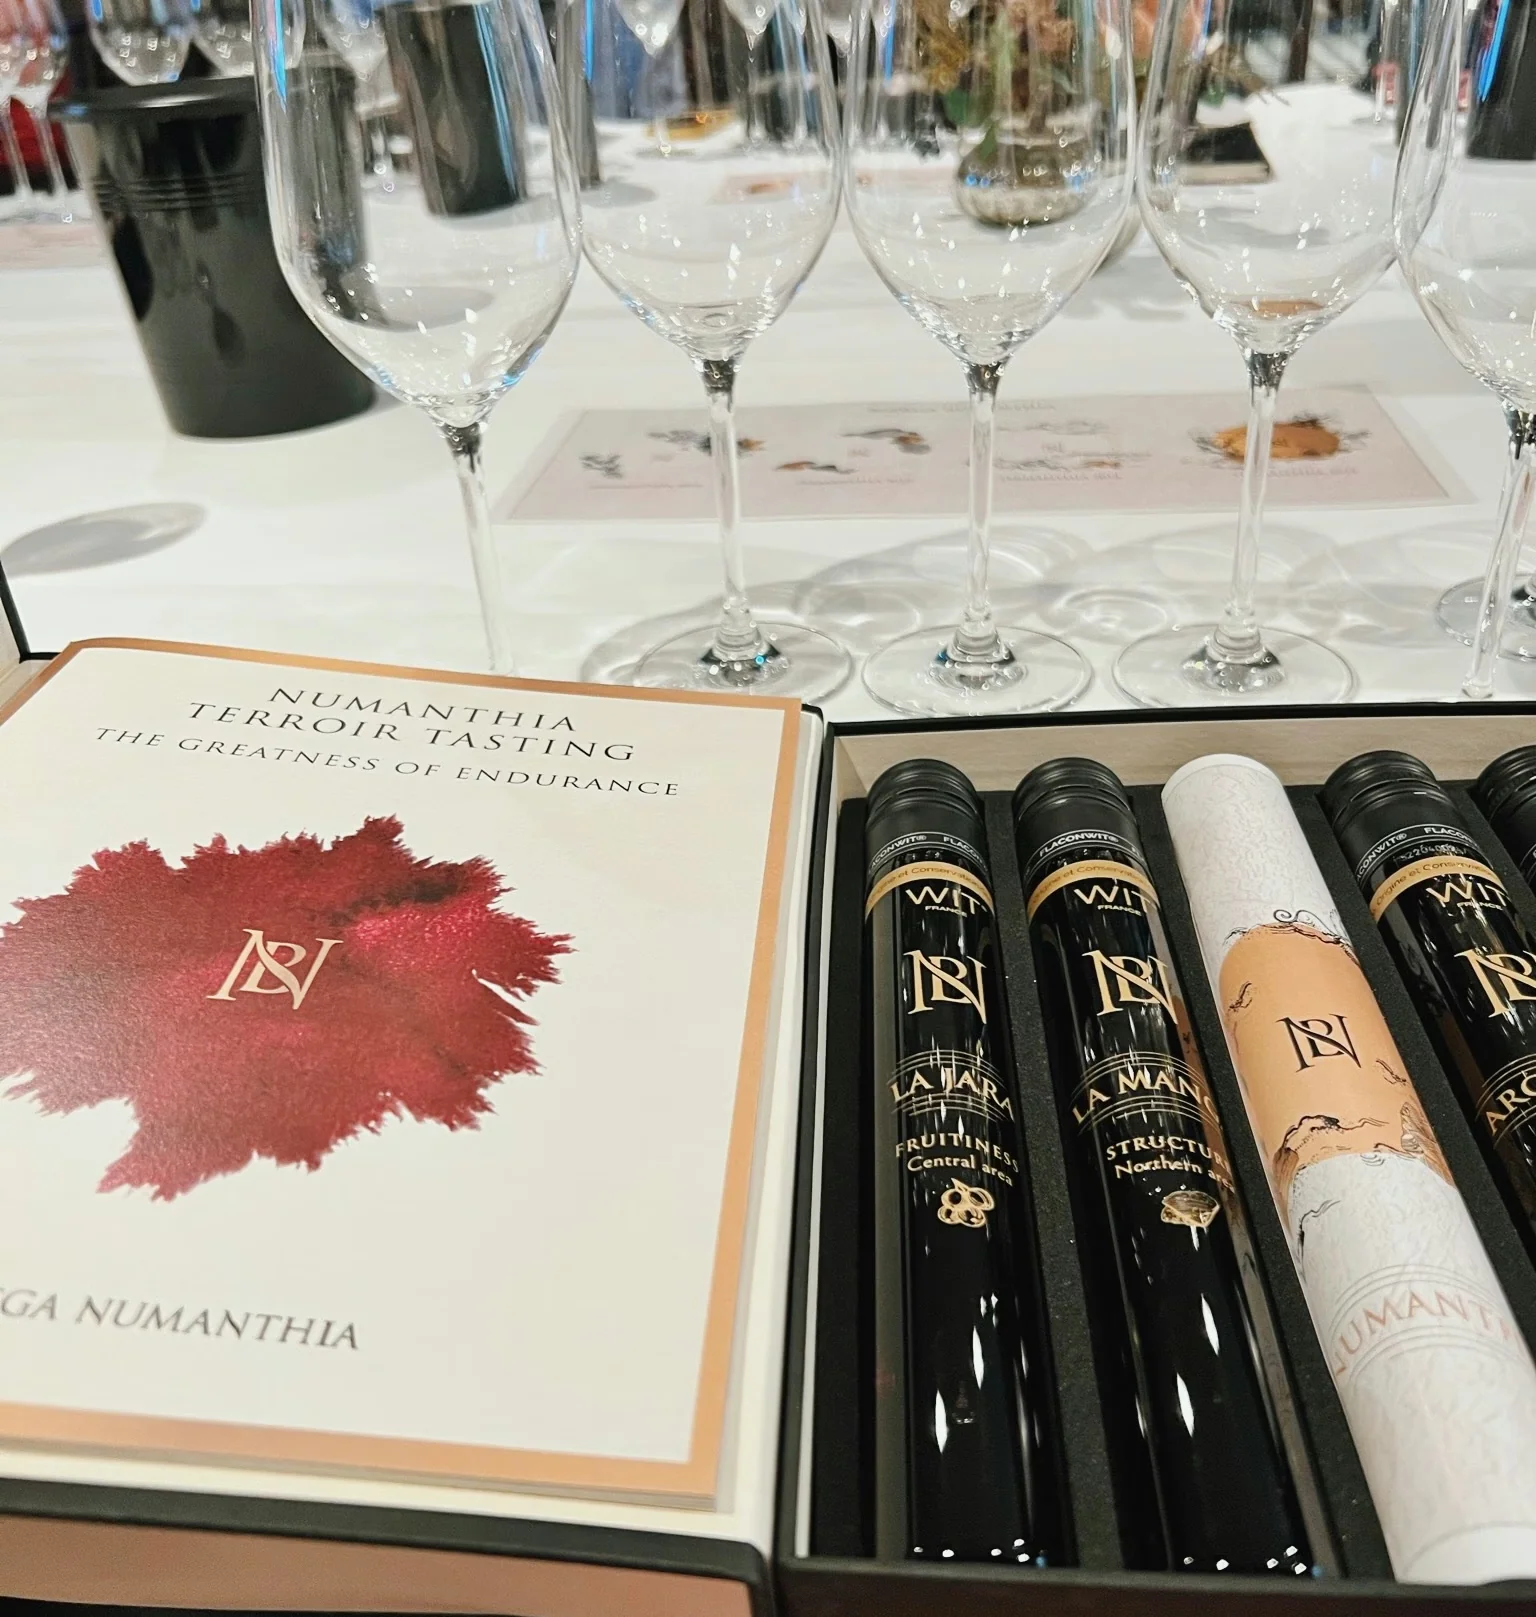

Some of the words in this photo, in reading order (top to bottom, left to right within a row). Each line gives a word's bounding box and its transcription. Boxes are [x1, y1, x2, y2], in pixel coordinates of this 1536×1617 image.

[267, 687, 577, 732] NUMANTHIA
[188, 702, 401, 742] TERROIR
[425, 727, 635, 761] TASTING
[96, 727, 165, 747] THE
[177, 738, 380, 771] GREATNESS
[394, 761, 441, 777] OF
[455, 766, 679, 796] ENDURANCE
[905, 885, 988, 915] WIT
[1073, 885, 1158, 913] WIT
[1097, 904, 1142, 917] FRANCE
[1425, 880, 1512, 907] WIT
[924, 905, 968, 918] FRANCE
[890, 1069, 934, 1103] LA
[942, 1067, 1015, 1122] JARA
[1072, 1087, 1112, 1124] LA
[895, 1132, 1019, 1173] FRUITINESS
[1115, 1155, 1203, 1179] Northern
[907, 1154, 976, 1172] Central
[981, 1163, 1013, 1187] area
[74, 1294, 359, 1350] NUMANTHIA
